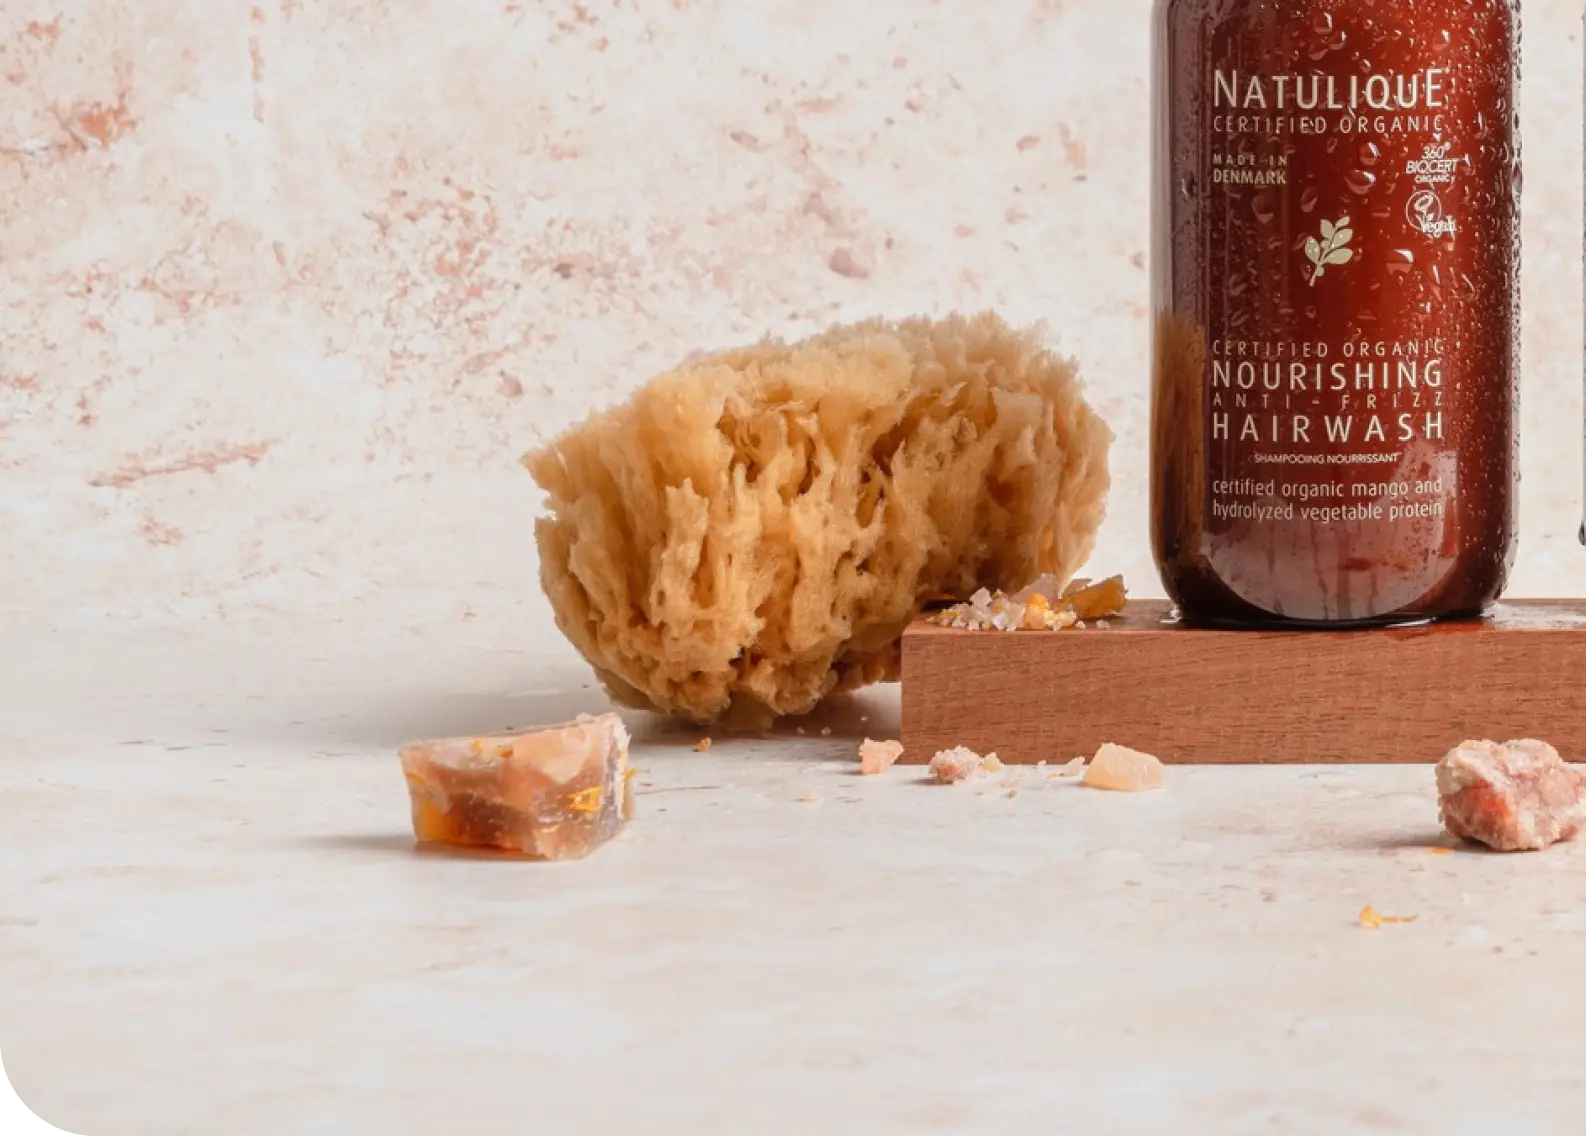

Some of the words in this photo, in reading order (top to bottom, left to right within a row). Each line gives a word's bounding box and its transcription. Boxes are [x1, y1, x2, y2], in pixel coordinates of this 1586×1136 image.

[1213, 115, 1327, 134] CERTIFIED
[1340, 115, 1443, 133] ORGANIC
[1212, 153, 1256, 166] MADE
[1269, 154, 1288, 166] IN
[1406, 159, 1457, 174] BIOCERT
[1213, 168, 1287, 185] DENMARK
[1213, 339, 1328, 357] CERTIFIED
[1343, 339, 1444, 356] ORGANIC
[1213, 360, 1442, 390] NOURISHING
[1213, 412, 1443, 442] HAIRWASH
[1254, 453, 1325, 464] SHAMPOOING
[1327, 452, 1398, 464] NOURRISSANT
[1213, 479, 1274, 496] certified
[1282, 479, 1344, 501] organic
[1352, 482, 1409, 500] mango
[1415, 478, 1442, 494] and
[1213, 501, 1294, 523] hydrolyzed
[1300, 503, 1384, 522] vegetable
[1389, 502, 1443, 521] protein
